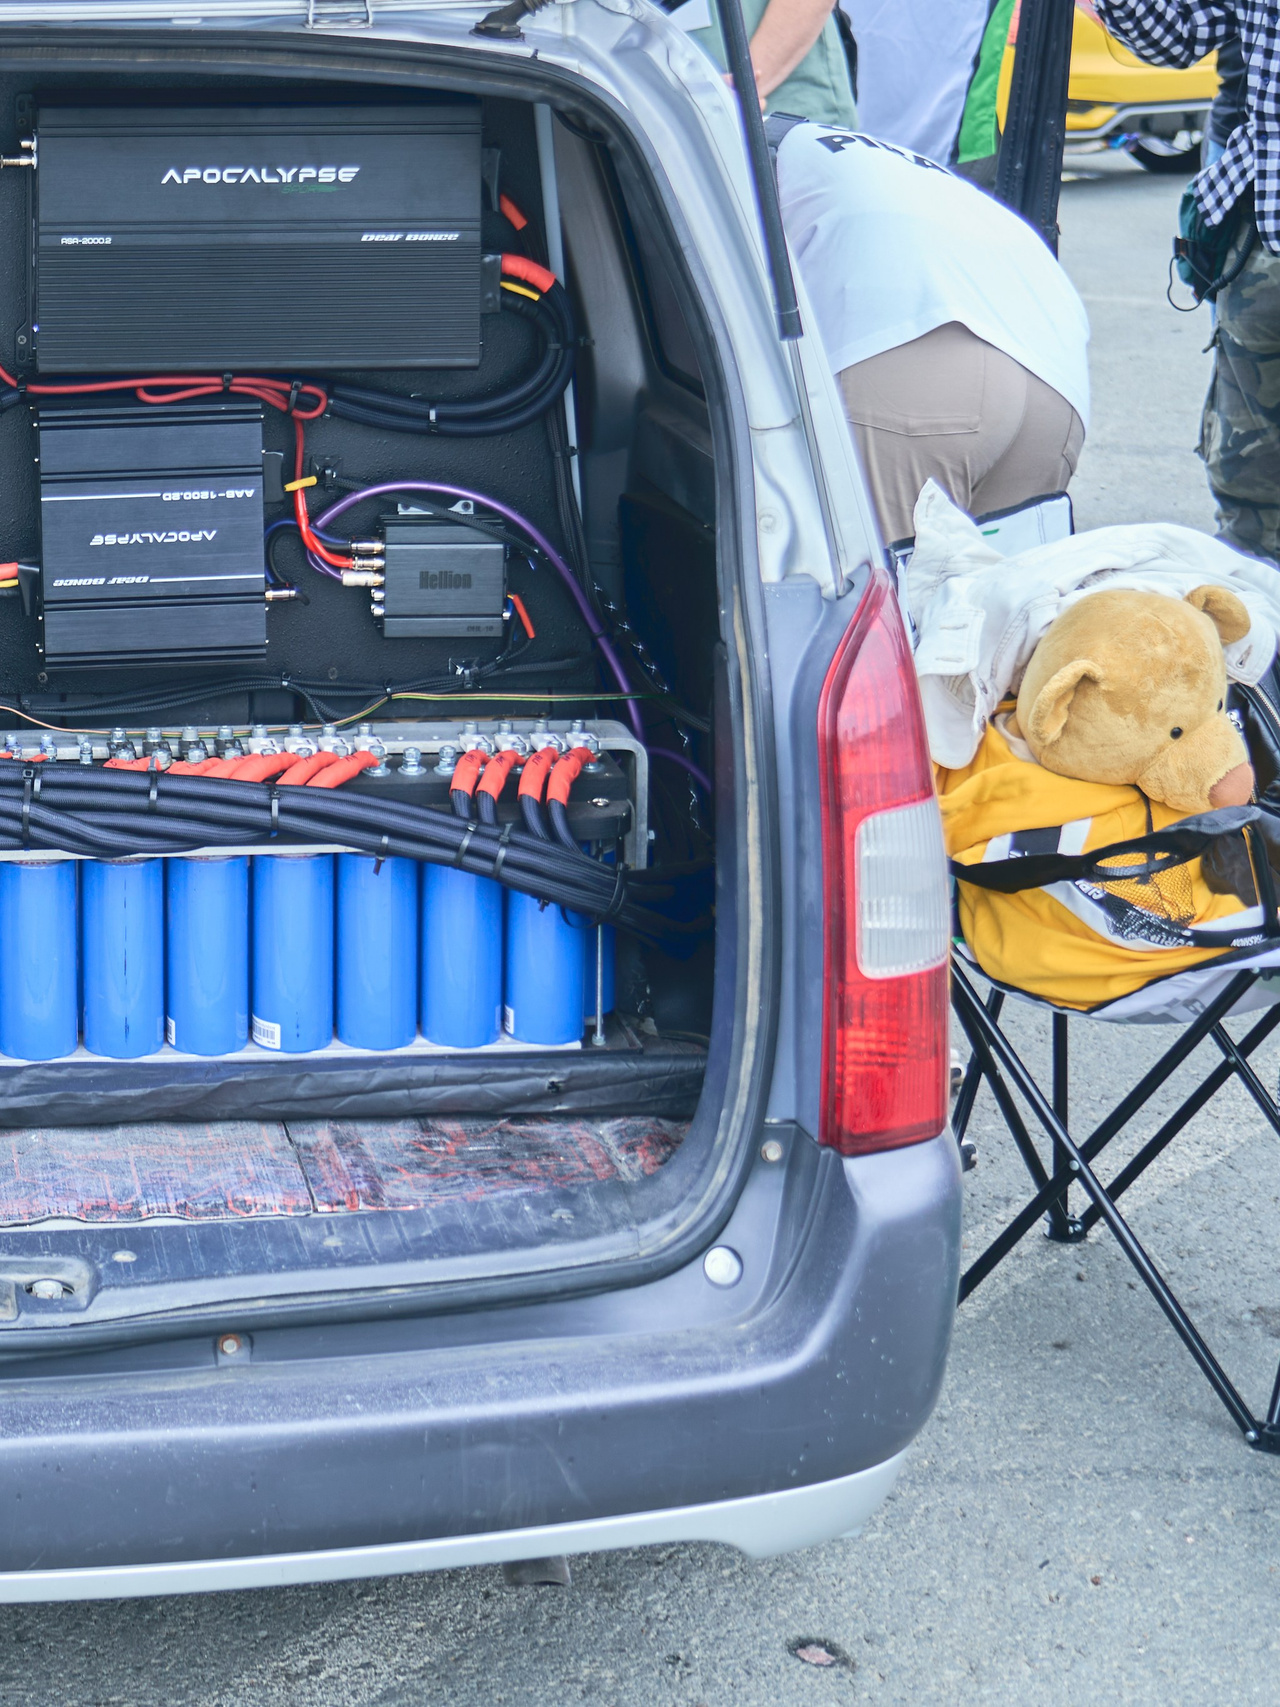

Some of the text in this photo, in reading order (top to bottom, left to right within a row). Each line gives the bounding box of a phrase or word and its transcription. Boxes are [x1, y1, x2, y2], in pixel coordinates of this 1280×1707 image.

[161, 167, 360, 184] APOCALYPSE
[162, 489, 255, 501] AAB-1200.2D
[90, 530, 217, 545] APOCALYPSE
[419, 571, 472, 590] Hellion
